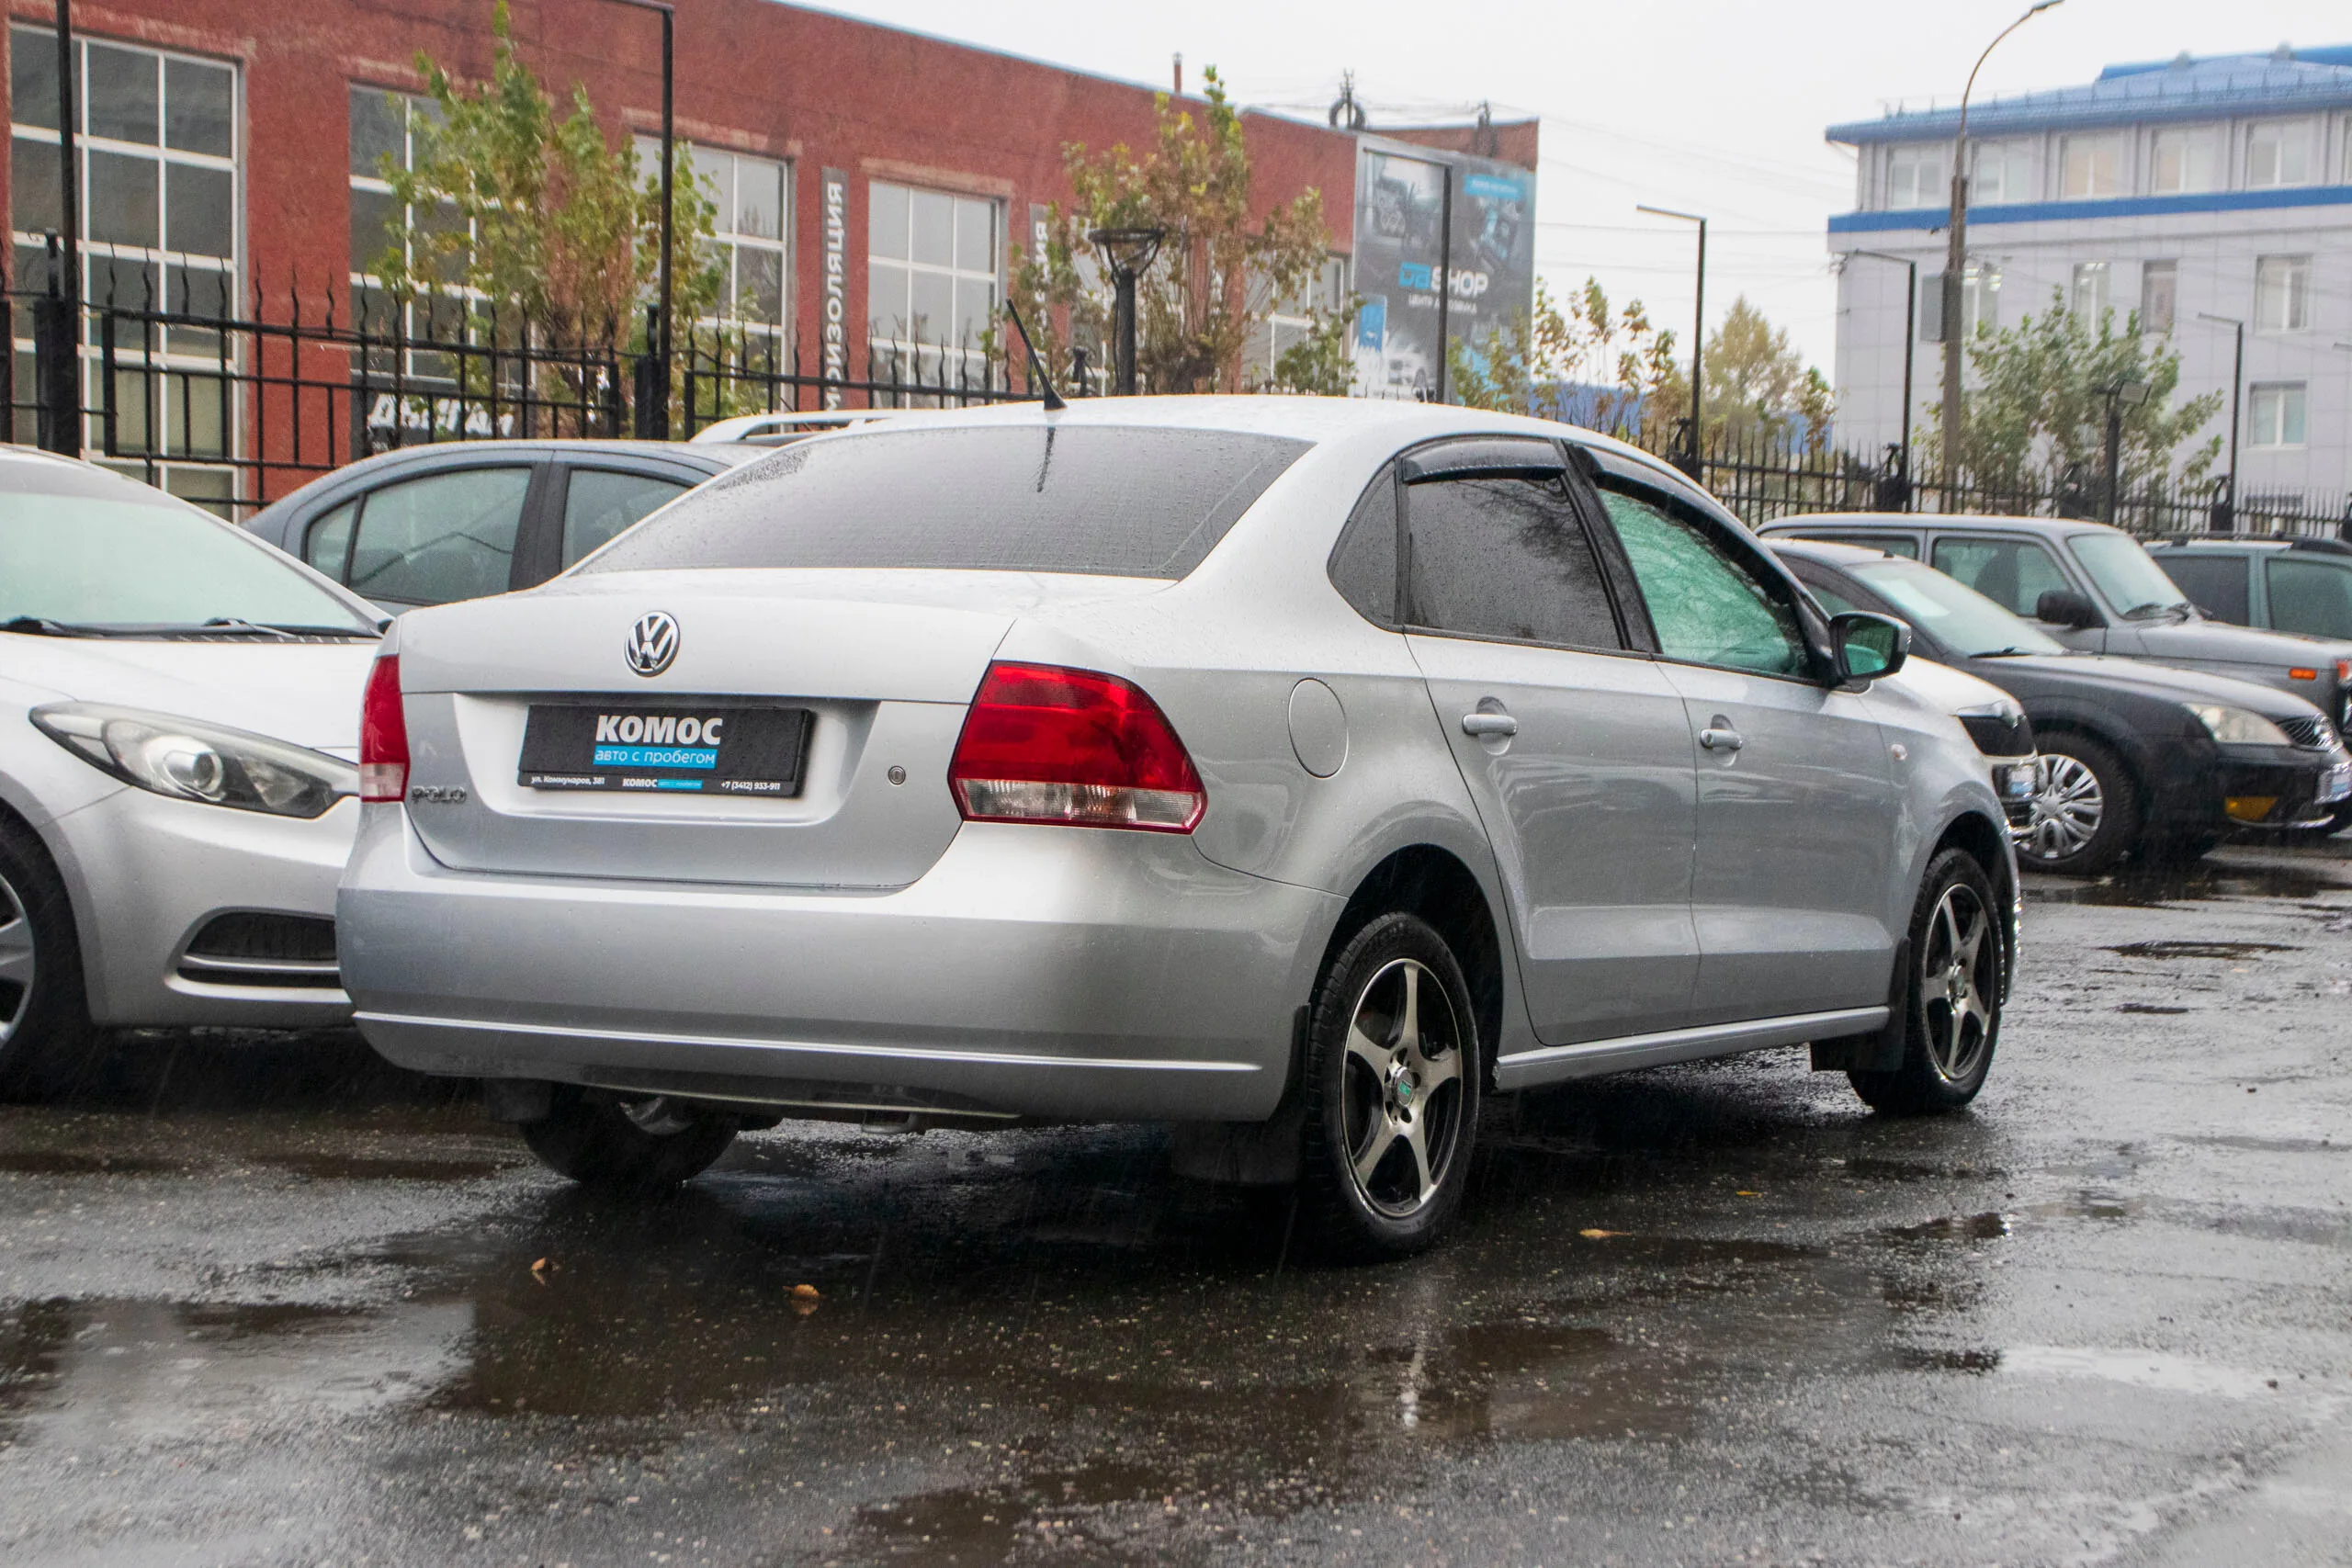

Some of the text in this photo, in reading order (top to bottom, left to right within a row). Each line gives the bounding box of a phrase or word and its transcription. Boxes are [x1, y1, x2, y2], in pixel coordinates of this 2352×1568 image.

[595, 715, 723, 745] КОМОС
[594, 750, 716, 764] авто с пробегом
[623, 778, 658, 787] КОМОС
[721, 781, 781, 791] +7 (3412) 933-911
[412, 785, 467, 804] POLO
